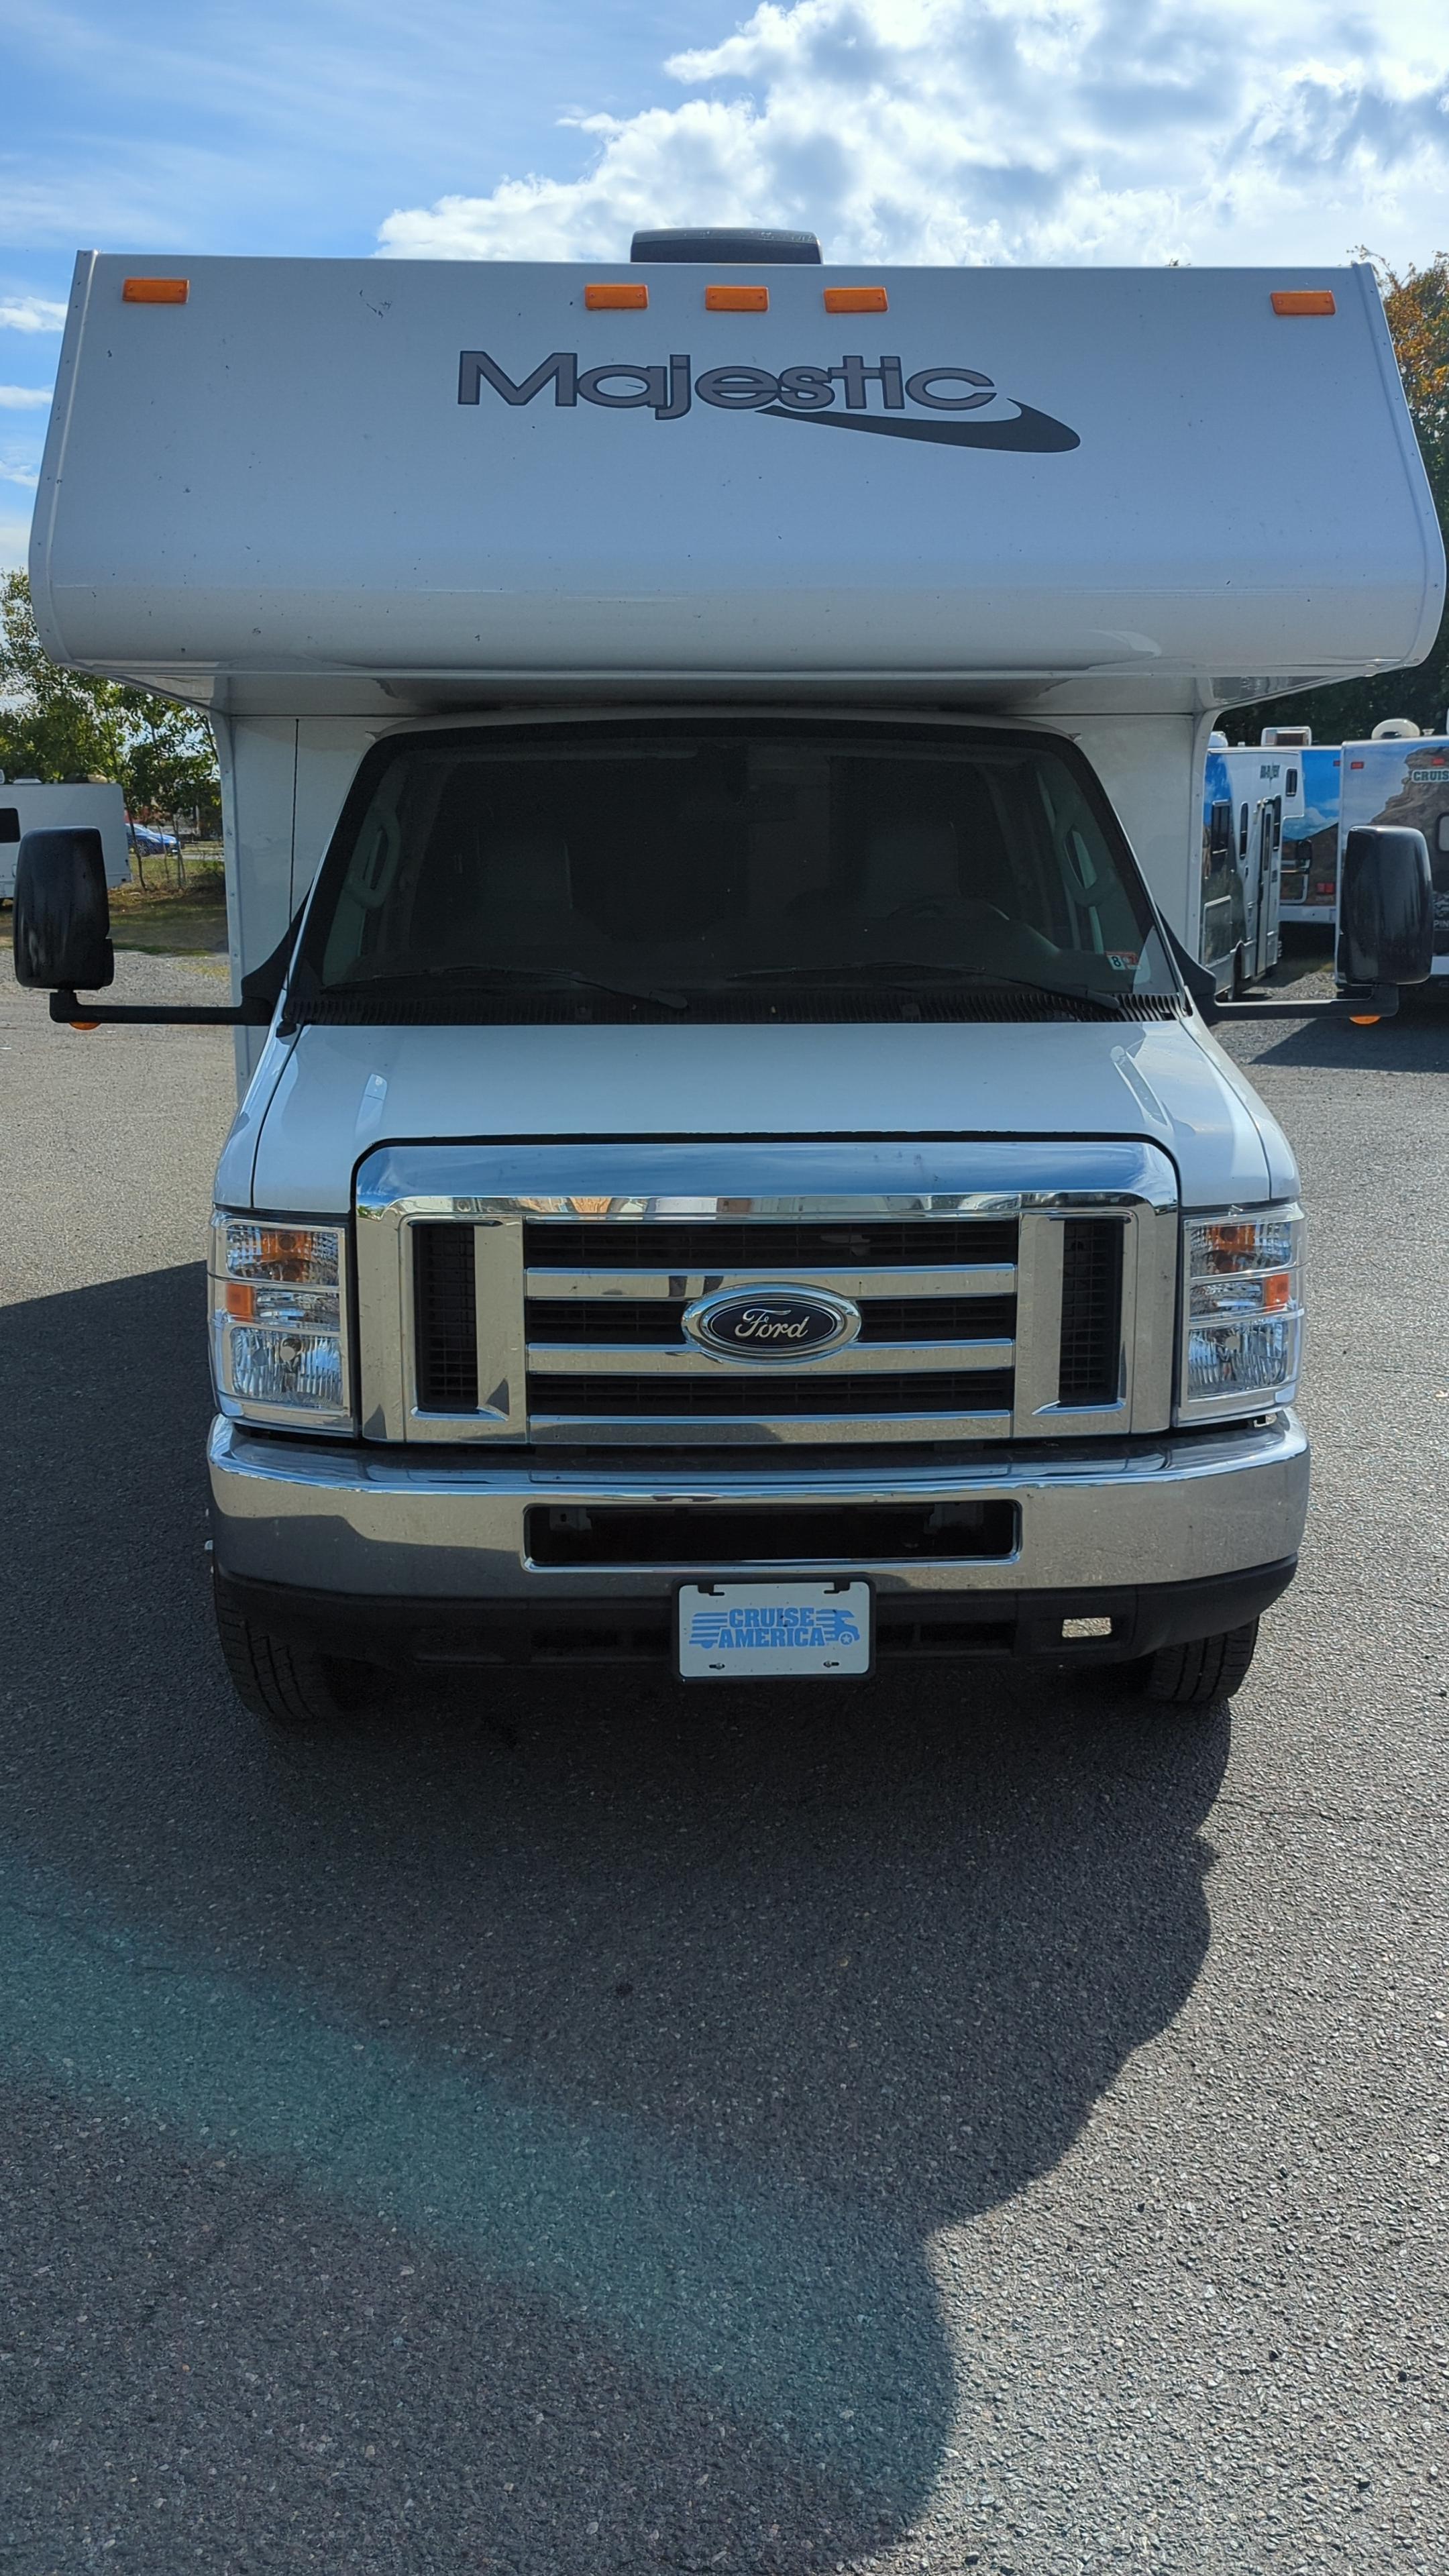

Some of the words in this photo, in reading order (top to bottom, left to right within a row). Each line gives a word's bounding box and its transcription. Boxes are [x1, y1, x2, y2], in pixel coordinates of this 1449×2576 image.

[457, 350, 997, 421] Majestic
[1112, 956, 1122, 967] 8
[735, 1308, 809, 1338] Ford
[729, 1607, 814, 1627] CRUISE
[719, 1628, 825, 1648] AMERICA
